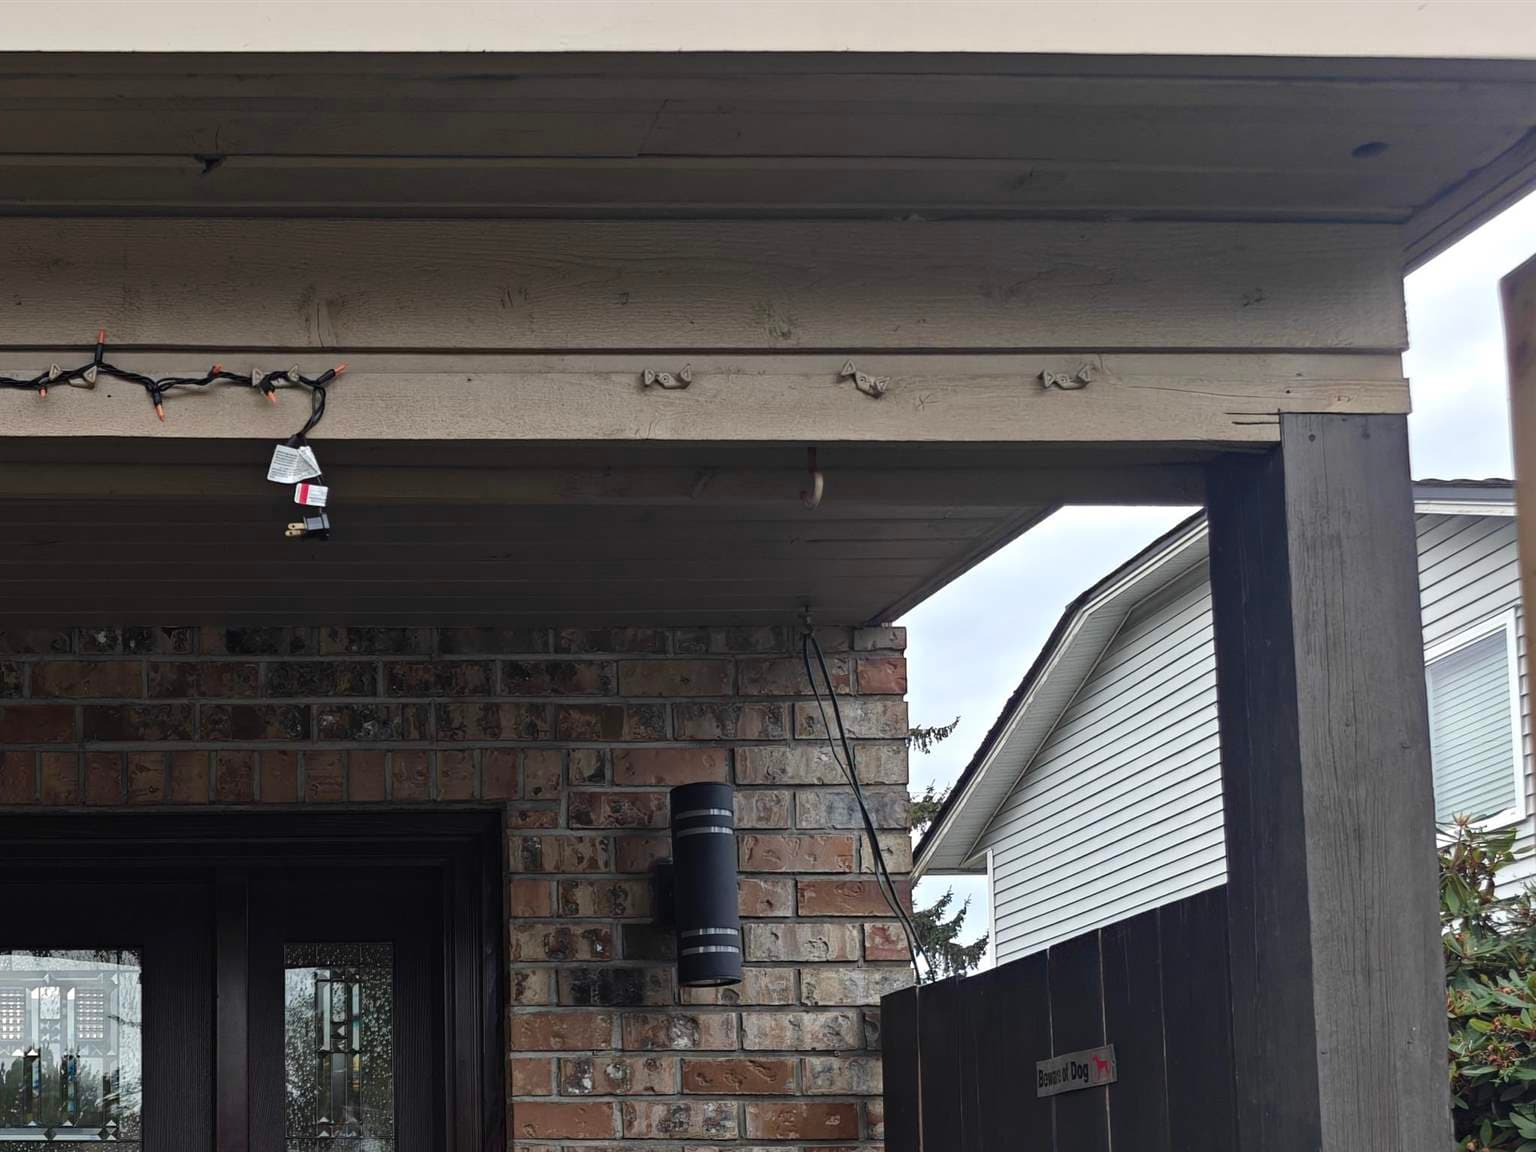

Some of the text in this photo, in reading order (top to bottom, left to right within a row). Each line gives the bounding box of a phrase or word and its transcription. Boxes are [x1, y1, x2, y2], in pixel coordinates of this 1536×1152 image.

[1038, 1061, 1089, 1089] Beware of Dog
